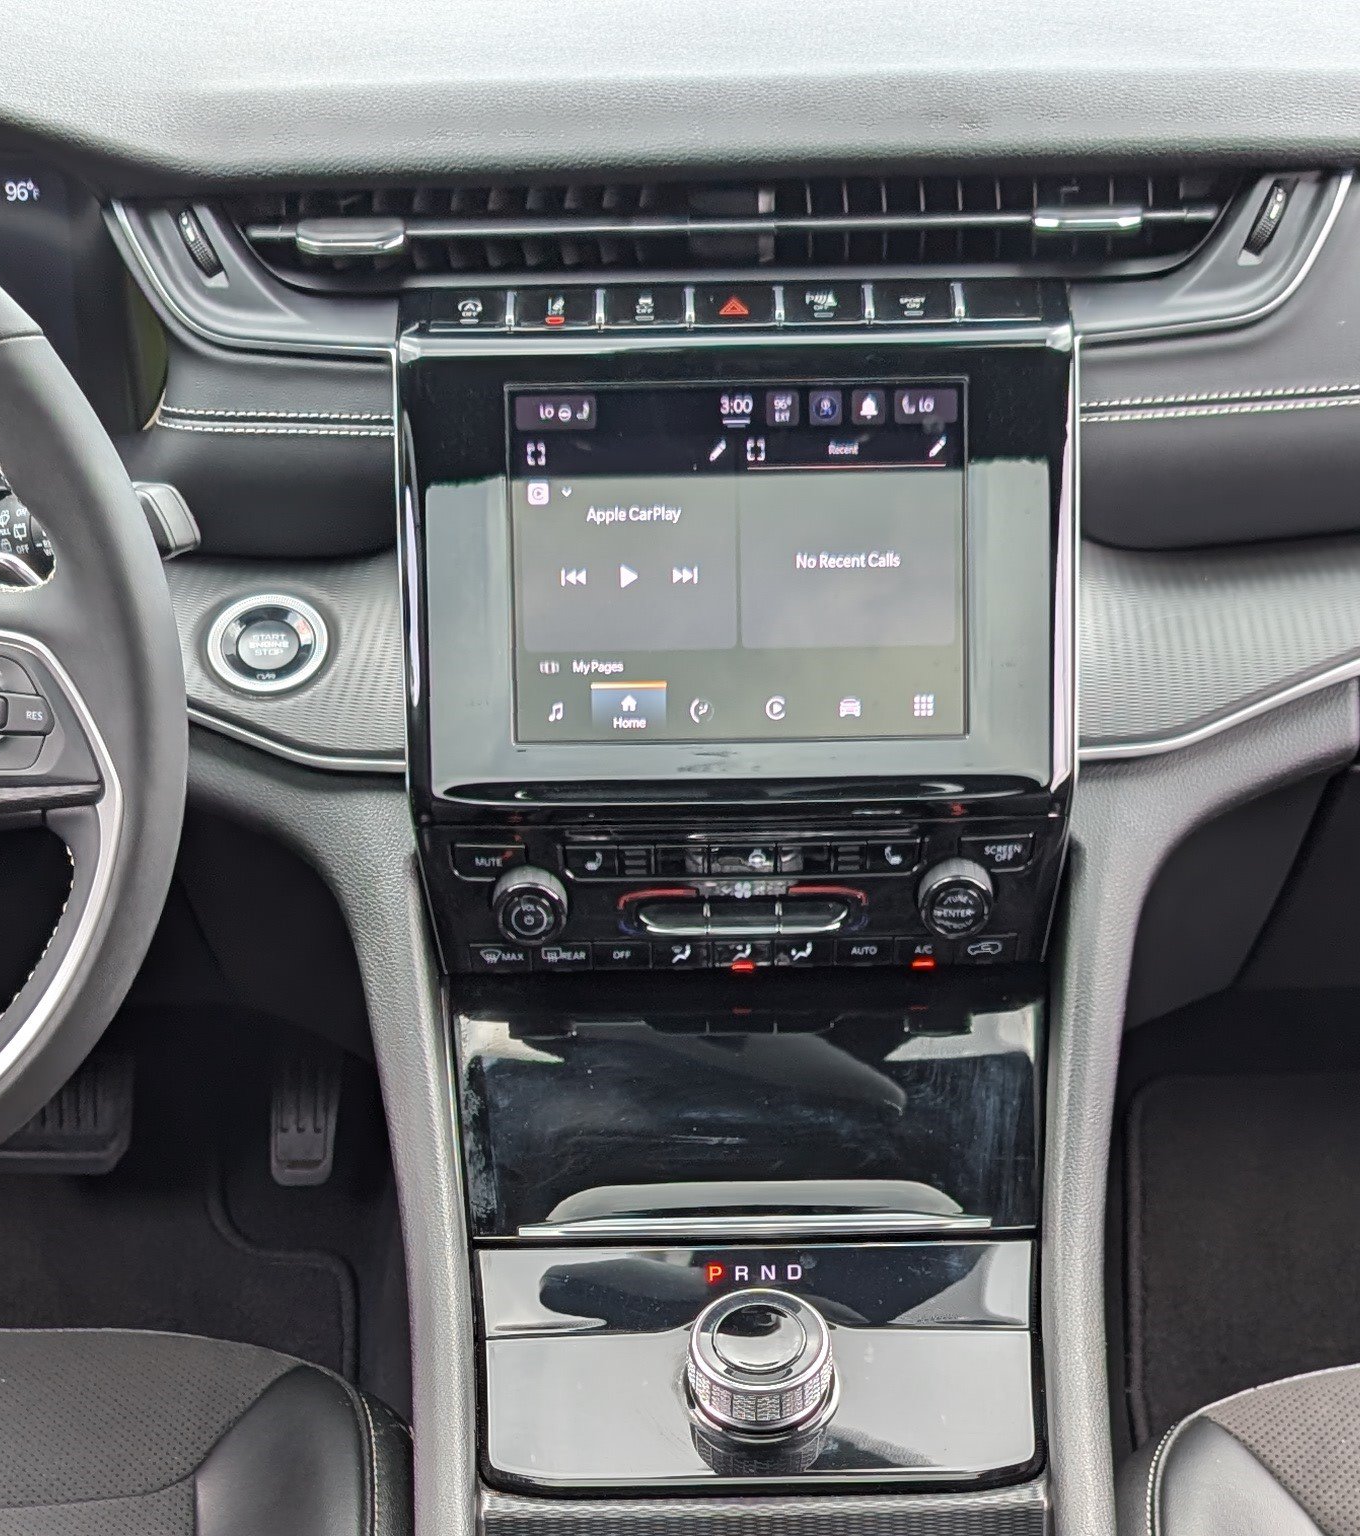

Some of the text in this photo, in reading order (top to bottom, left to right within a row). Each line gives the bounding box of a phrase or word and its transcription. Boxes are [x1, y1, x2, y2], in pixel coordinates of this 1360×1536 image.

[720, 396, 754, 415] 3:00
[828, 441, 859, 455] Recent
[586, 505, 682, 525] Apple CarPlay
[16, 544, 29, 554] OFF
[796, 551, 901, 569] No Recent Calls
[248, 641, 290, 649] ENGINE
[572, 660, 624, 674] My Pages
[26, 711, 43, 721] RES
[612, 717, 647, 729] Home
[984, 844, 1023, 855] SCREEN
[474, 857, 502, 868] MUTE
[994, 853, 1013, 862] OFF
[943, 909, 974, 918] ENTER
[850, 945, 877, 955] AUTO
[914, 944, 933, 954] A/C
[502, 953, 524, 961] MAX
[560, 951, 586, 960] REAR
[612, 951, 631, 960] OFF
[709, 1264, 802, 1281] P R N D
